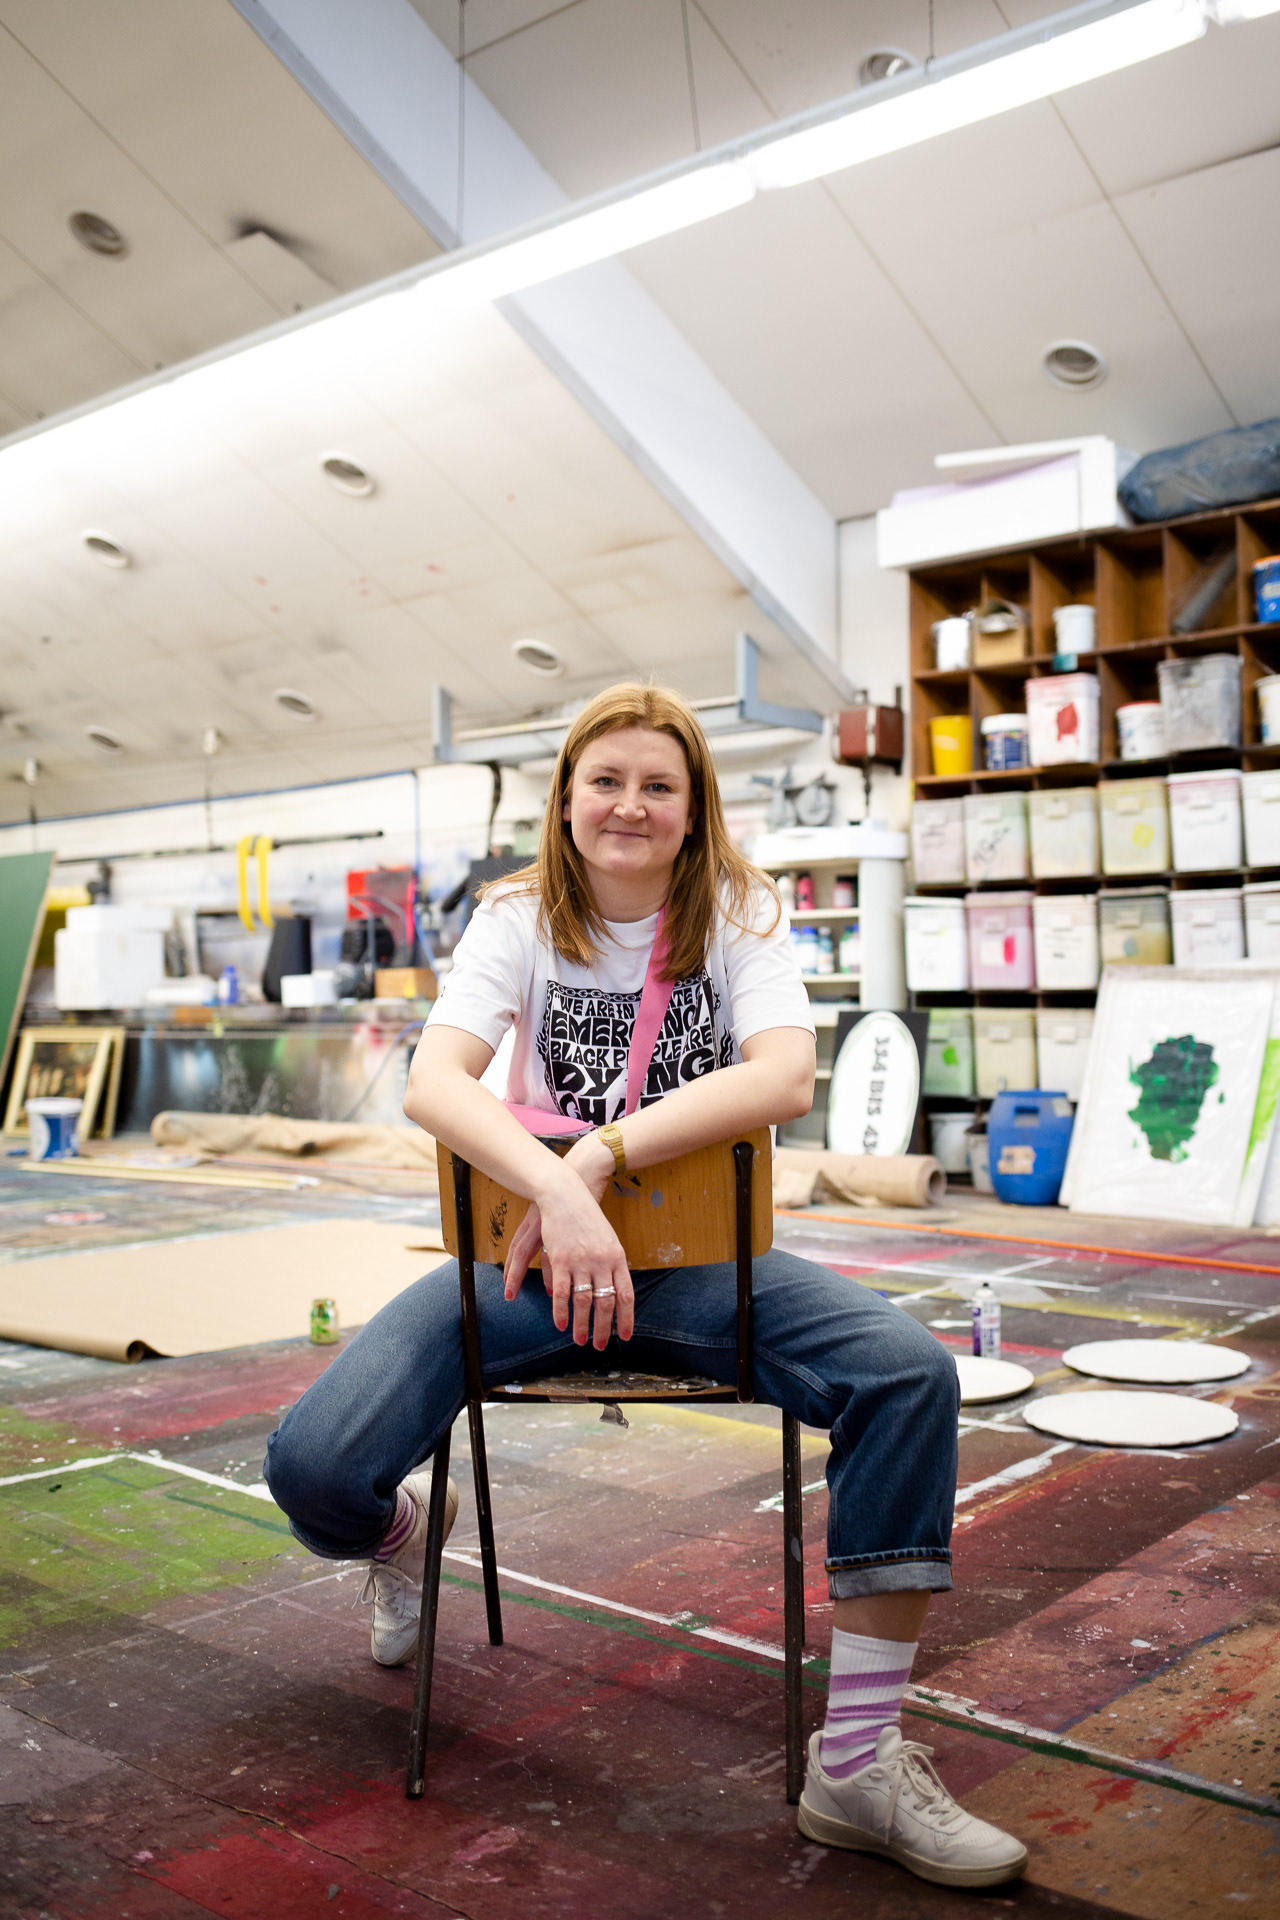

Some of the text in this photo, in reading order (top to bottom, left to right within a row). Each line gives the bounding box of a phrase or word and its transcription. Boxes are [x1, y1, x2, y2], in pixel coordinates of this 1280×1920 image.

[585, 1000, 615, 1018] ARE
[615, 1003, 635, 1019] IN
[551, 1040, 610, 1068] BLACK
[551, 1047, 715, 1096] DYNG
